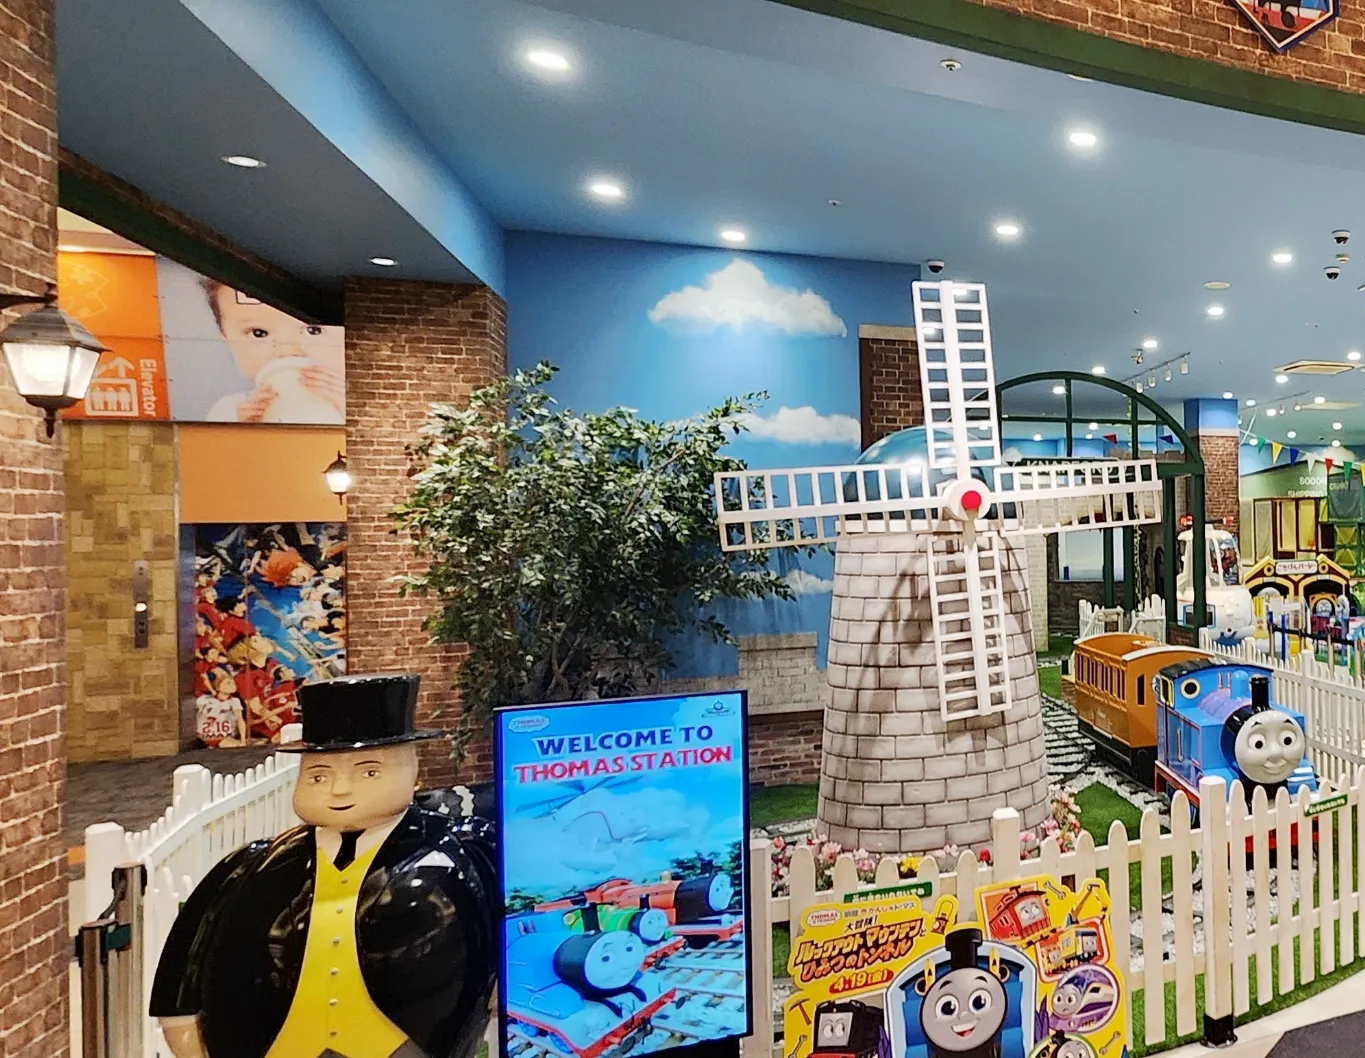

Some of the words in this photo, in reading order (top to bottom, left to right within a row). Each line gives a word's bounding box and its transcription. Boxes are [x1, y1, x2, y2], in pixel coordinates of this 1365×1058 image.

[140, 358, 158, 417] Elevator
[536, 728, 674, 756] WELCOME
[680, 725, 714, 743] TO
[513, 755, 627, 784] THOMAS
[630, 745, 733, 772] STATION
[810, 911, 839, 920] THOMAS
[794, 931, 864, 967] ルックアウト
[800, 938, 914, 982] ひみつのトンネル
